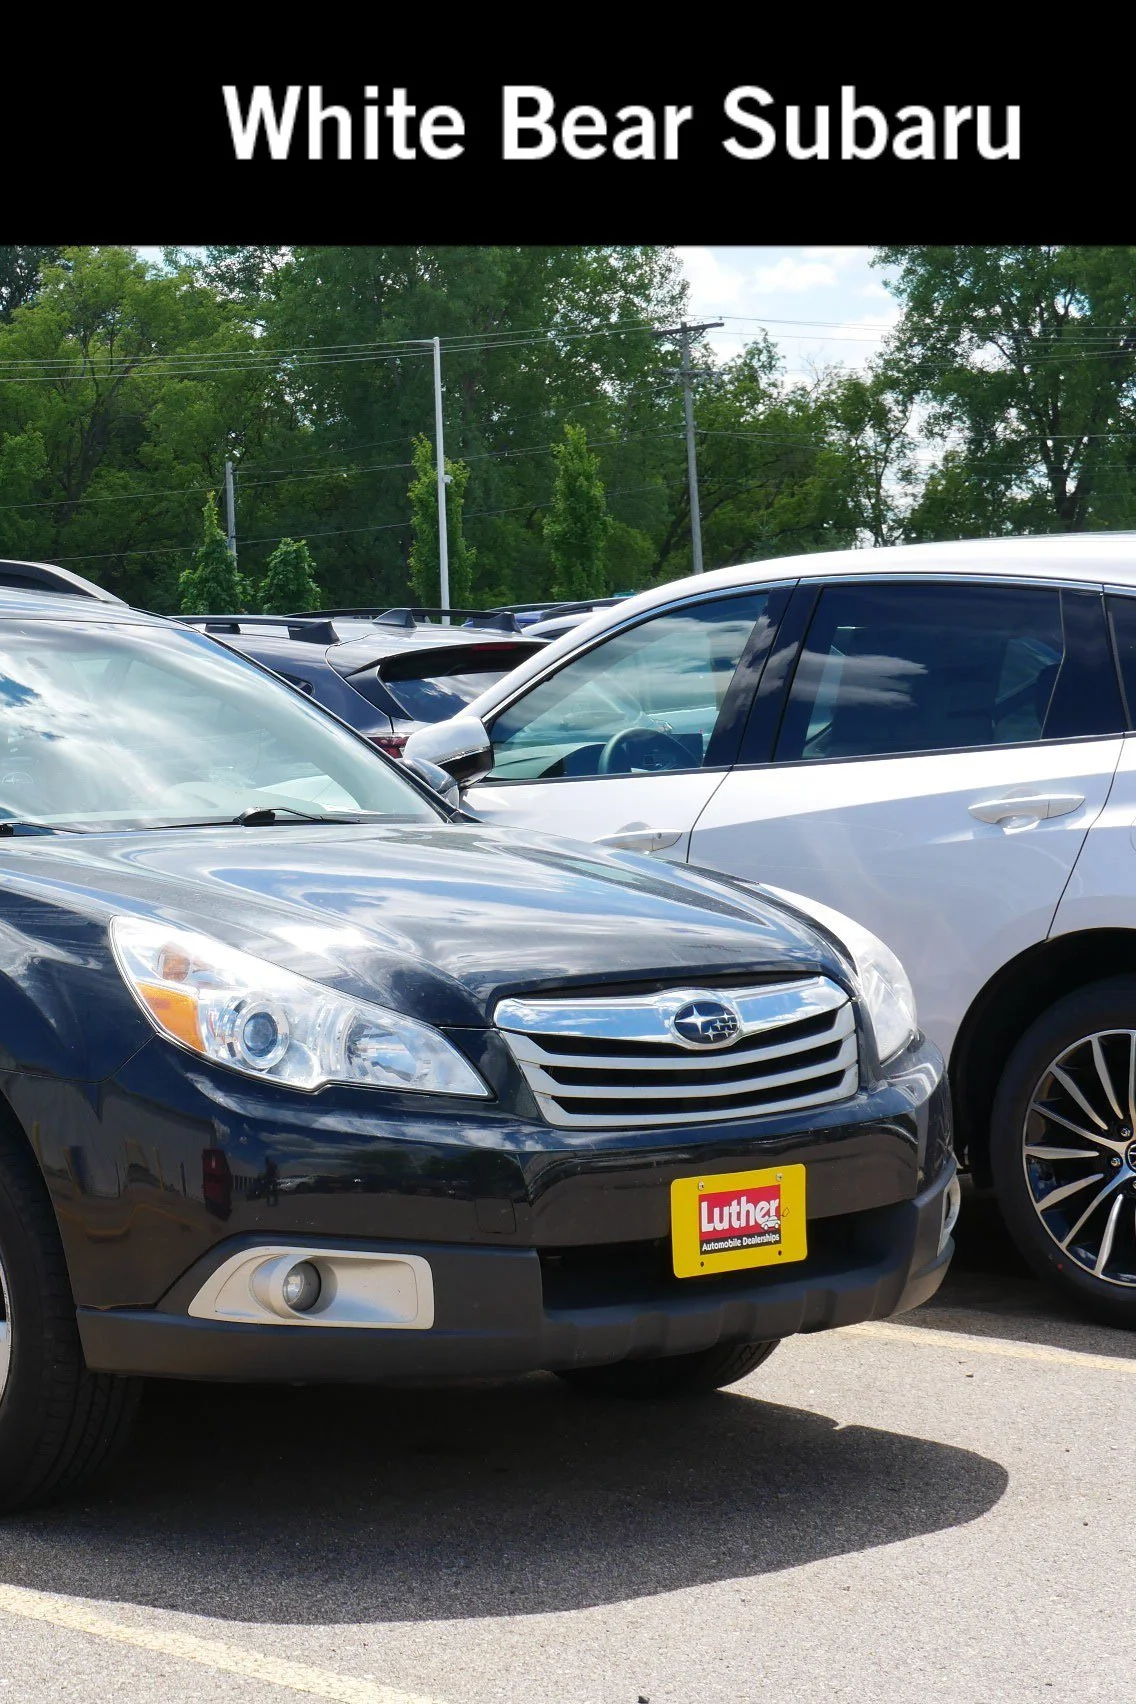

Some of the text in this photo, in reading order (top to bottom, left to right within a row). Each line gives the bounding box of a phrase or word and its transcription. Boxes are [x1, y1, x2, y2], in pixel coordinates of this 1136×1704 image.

[701, 1196, 779, 1232] Luther
[702, 1233, 780, 1251] Automobile Dealerships
